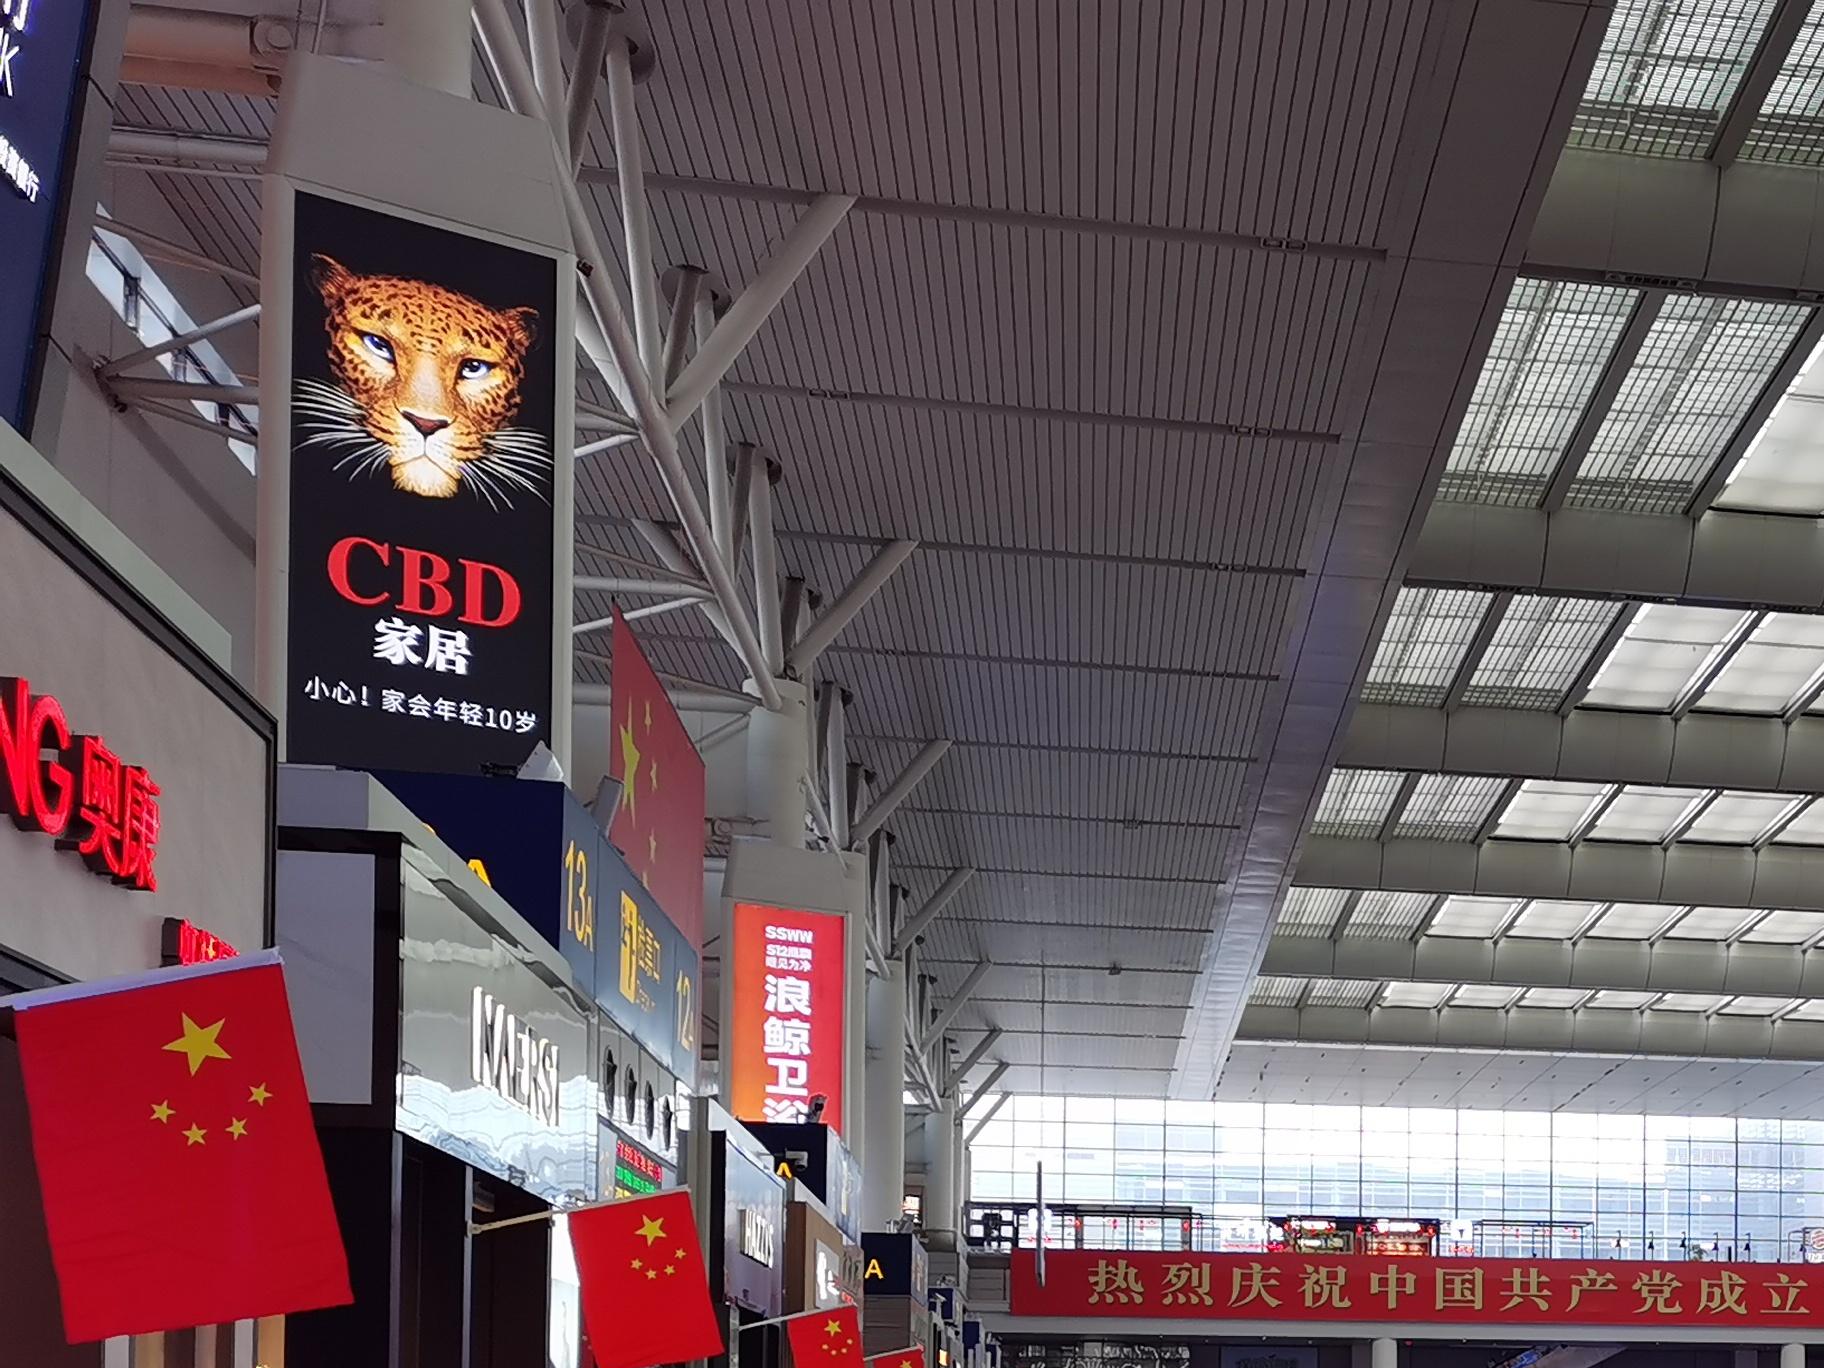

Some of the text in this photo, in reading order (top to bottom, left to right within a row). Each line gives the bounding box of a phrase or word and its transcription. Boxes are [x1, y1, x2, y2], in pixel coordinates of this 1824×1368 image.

[326, 535, 522, 629] CBD
[372, 618, 471, 675] 家居
[564, 839, 594, 953] 13A
[765, 924, 813, 945] SSWW
[763, 974, 812, 1124] 浪鲸卫浴
